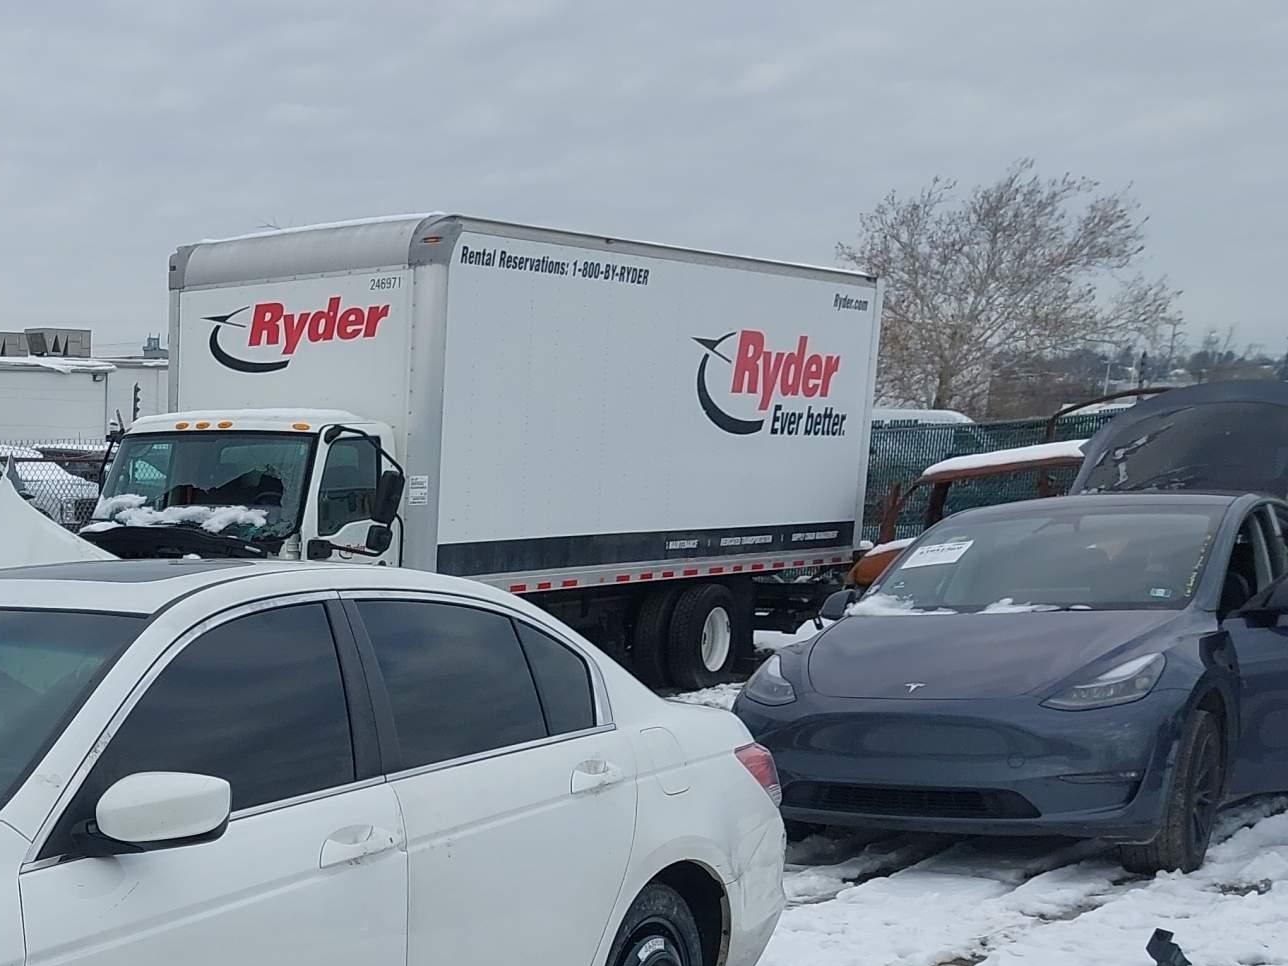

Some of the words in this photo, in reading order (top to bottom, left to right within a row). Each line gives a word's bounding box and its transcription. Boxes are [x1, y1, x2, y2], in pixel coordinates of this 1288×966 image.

[370, 276, 401, 291] 246971
[460, 245, 497, 267] Rental
[498, 250, 569, 276] Reservations:
[572, 259, 650, 286] 1-800-BY-RYDER
[247, 296, 391, 356] Ryder
[730, 329, 841, 411] Ryder
[770, 404, 803, 435] Ever
[804, 405, 847, 436] better.
